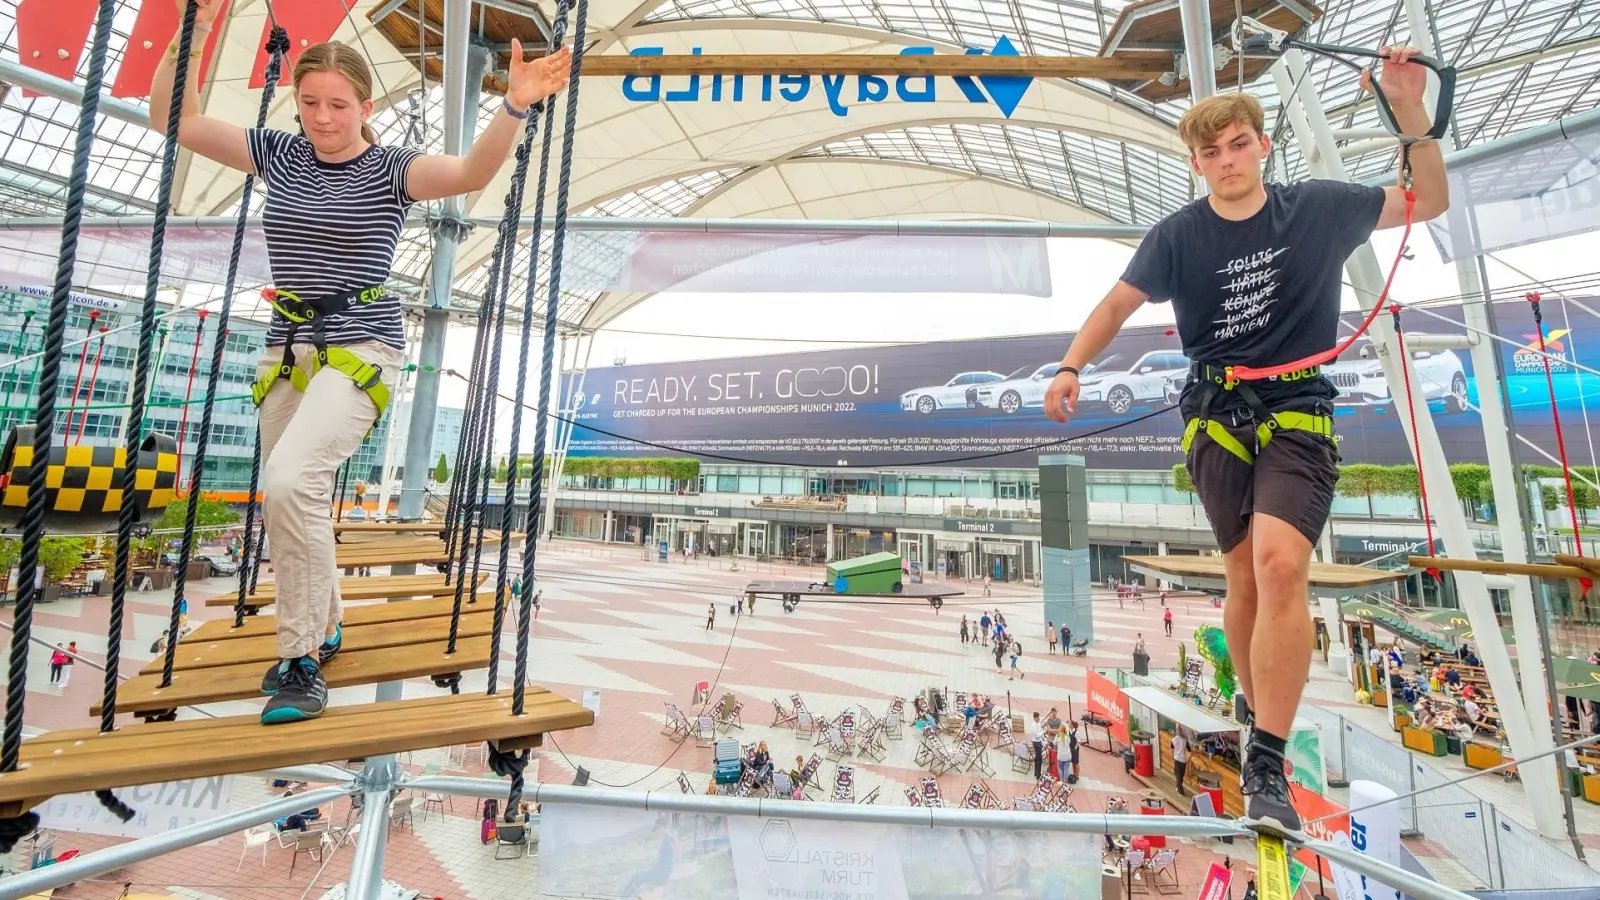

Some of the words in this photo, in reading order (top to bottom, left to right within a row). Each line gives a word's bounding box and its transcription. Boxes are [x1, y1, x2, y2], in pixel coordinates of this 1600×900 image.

[614, 375, 697, 405] READY.
[708, 371, 763, 401] SET.
[626, 409, 656, 418] CHARGED
[656, 409, 666, 417] UP
[668, 408, 680, 416] FOR
[682, 408, 696, 416] THE
[697, 406, 736, 416] EUROPEAN
[737, 404, 798, 414] CHAMPIONSHIPS
[800, 403, 832, 412] MUNICH
[834, 402, 857, 412] 2022.
[694, 508, 714, 516] Terminal
[957, 521, 988, 532] Terminal
[990, 523, 994, 532] 2
[1362, 540, 1408, 552] Terminal
[1411, 542, 1418, 553] 2
